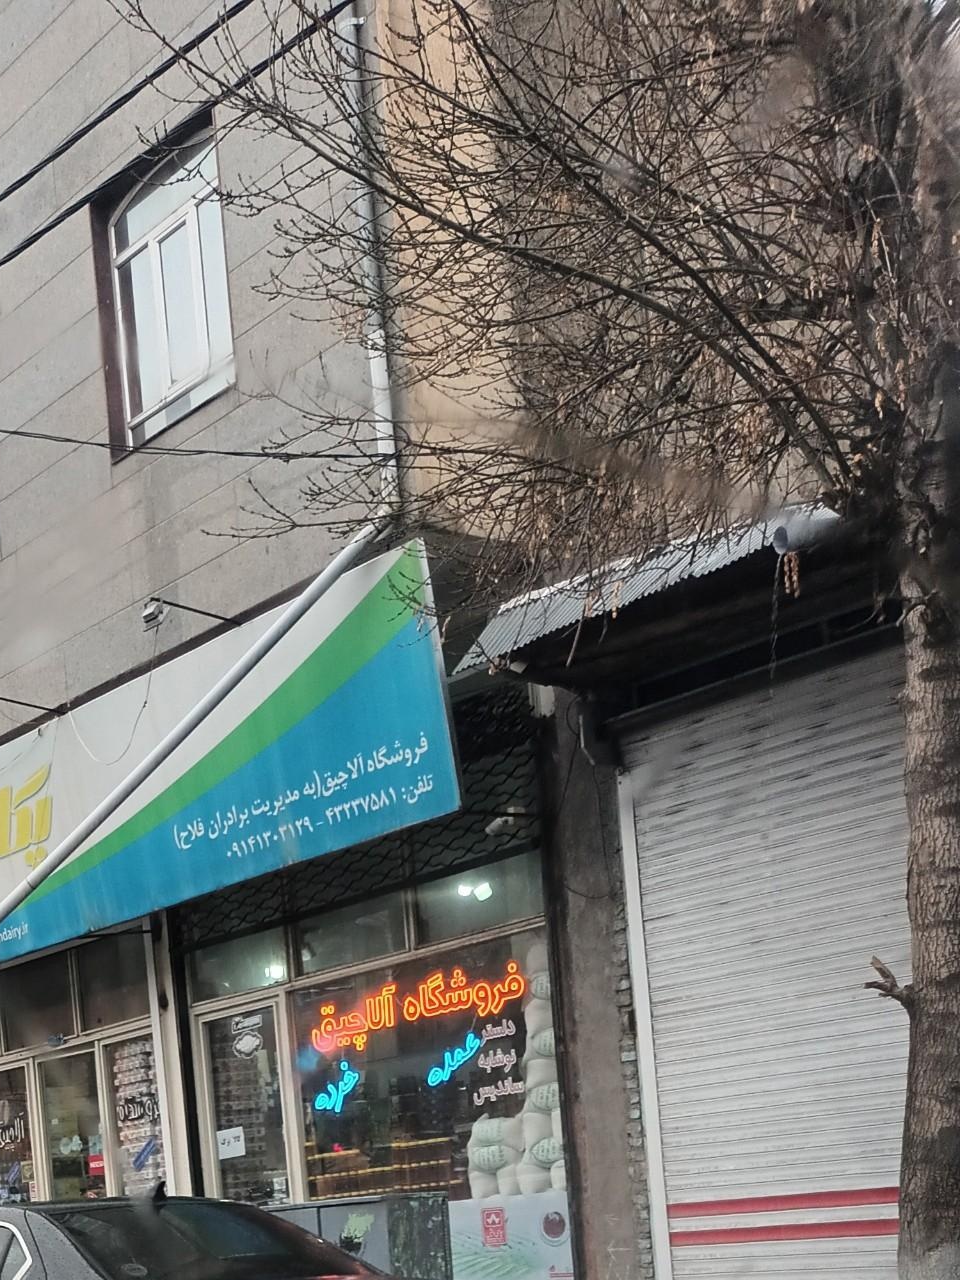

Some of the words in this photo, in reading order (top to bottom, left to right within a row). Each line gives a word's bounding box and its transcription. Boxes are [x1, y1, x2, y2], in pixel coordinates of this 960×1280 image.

[367, 731, 429, 773] فروشگاه
[251, 789, 300, 816] مدیریت
[401, 774, 434, 804] تلفن:
[173, 817, 205, 850] فلاح)
[208, 804, 250, 839] برادران
[403, 961, 526, 1022] فروشگاه
[311, 985, 397, 1052] آلاچیق
[480, 1018, 517, 1048] دلستر
[427, 1031, 482, 1087] عمده
[477, 1048, 517, 1073] نوشابه
[313, 1060, 361, 1114] خرده
[473, 1077, 525, 1107] ساندیس
